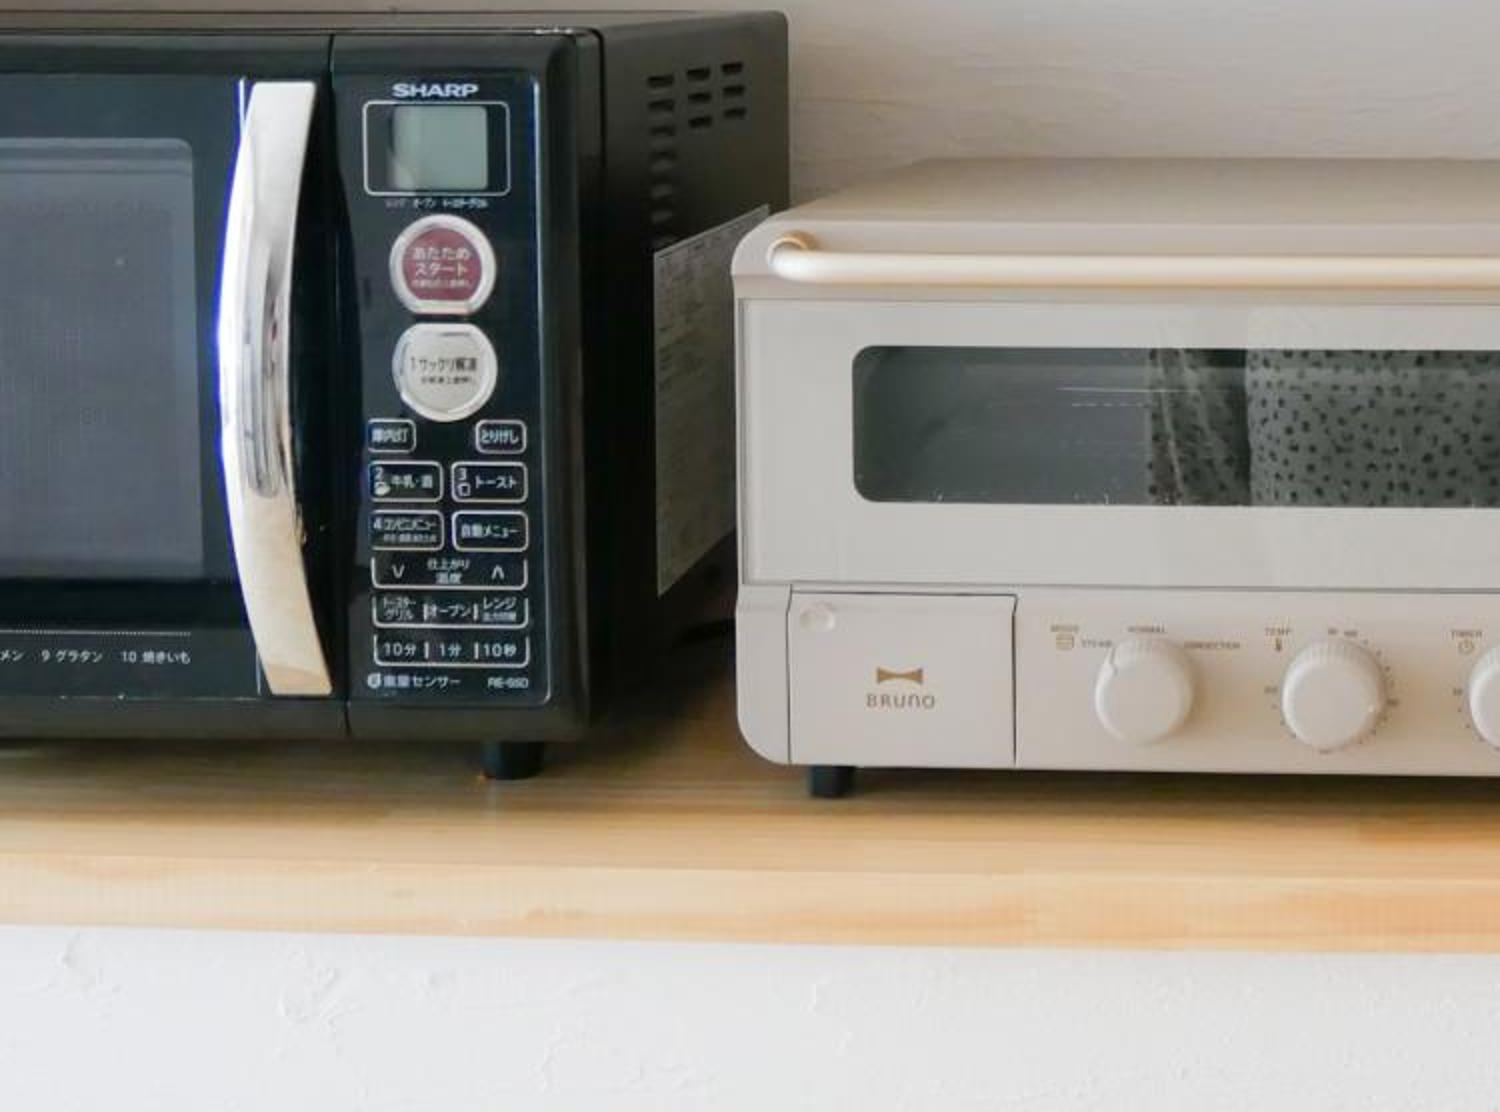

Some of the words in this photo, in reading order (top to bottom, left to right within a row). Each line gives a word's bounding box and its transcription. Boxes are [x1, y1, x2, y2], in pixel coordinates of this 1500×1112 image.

[391, 82, 479, 99] SHARP
[413, 247, 471, 261] あたため
[415, 262, 469, 276] スタート
[481, 429, 520, 444] とりけし
[475, 475, 517, 489] トースト
[461, 524, 520, 538] 自動メニュー
[483, 596, 517, 609] レンジ
[41, 649, 51, 663] 9
[56, 649, 103, 663] グラタン
[383, 642, 417, 657] 10分
[439, 642, 461, 657] 1分
[483, 642, 517, 657] 10秒
[121, 650, 137, 663] 10
[142, 651, 191, 664] 焼きいも
